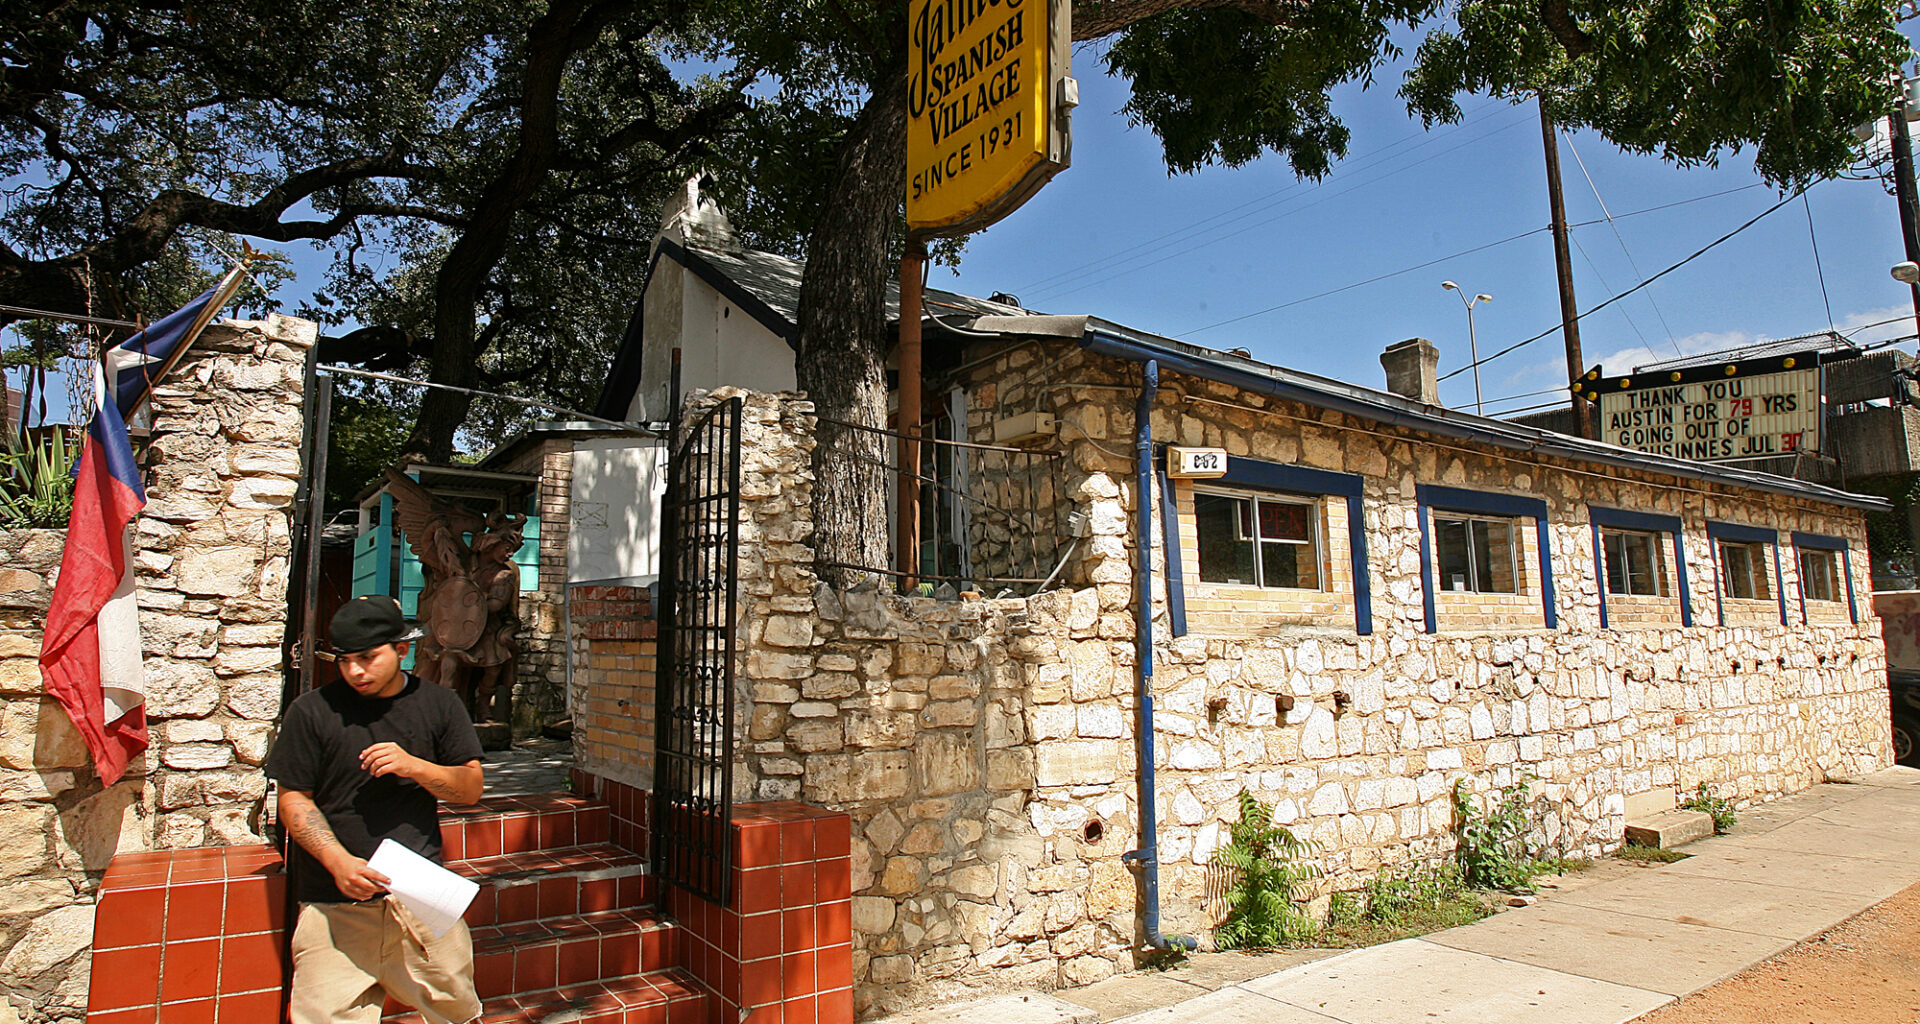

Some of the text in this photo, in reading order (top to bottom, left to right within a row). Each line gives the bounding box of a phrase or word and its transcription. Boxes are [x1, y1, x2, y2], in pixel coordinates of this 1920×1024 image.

[928, 10, 1024, 108] SPANISH
[928, 58, 1021, 145] VILLAGE
[912, 111, 1022, 199] SINCE 1931
[1610, 393, 1797, 430] AUSTIN FOR 79 YRS
[1627, 381, 1743, 409] THANK YOU
[1619, 418, 1750, 446] GOING OUT OF
[1638, 438, 1732, 459] SINNES
[1741, 435, 1774, 454] JUL
